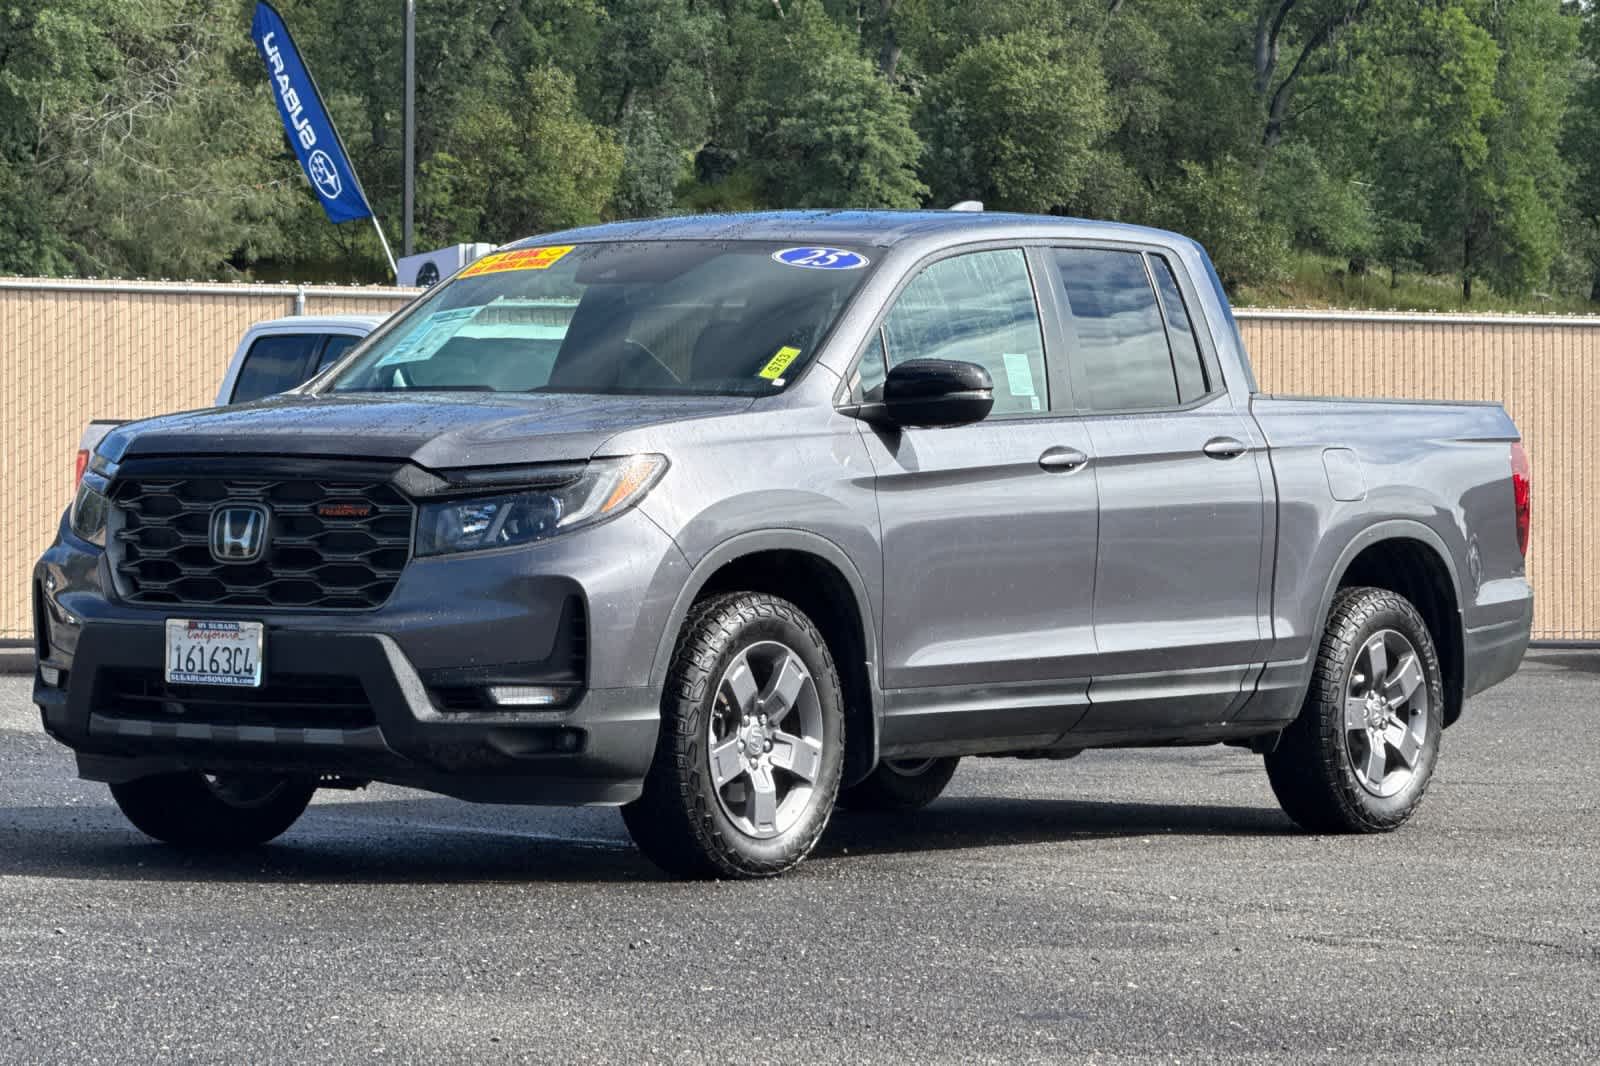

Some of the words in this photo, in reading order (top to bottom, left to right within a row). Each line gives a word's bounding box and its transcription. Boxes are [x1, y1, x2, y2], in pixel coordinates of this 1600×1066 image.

[790, 249, 850, 266] 25
[186, 629, 239, 643] California
[173, 644, 254, 675] 16163C4
